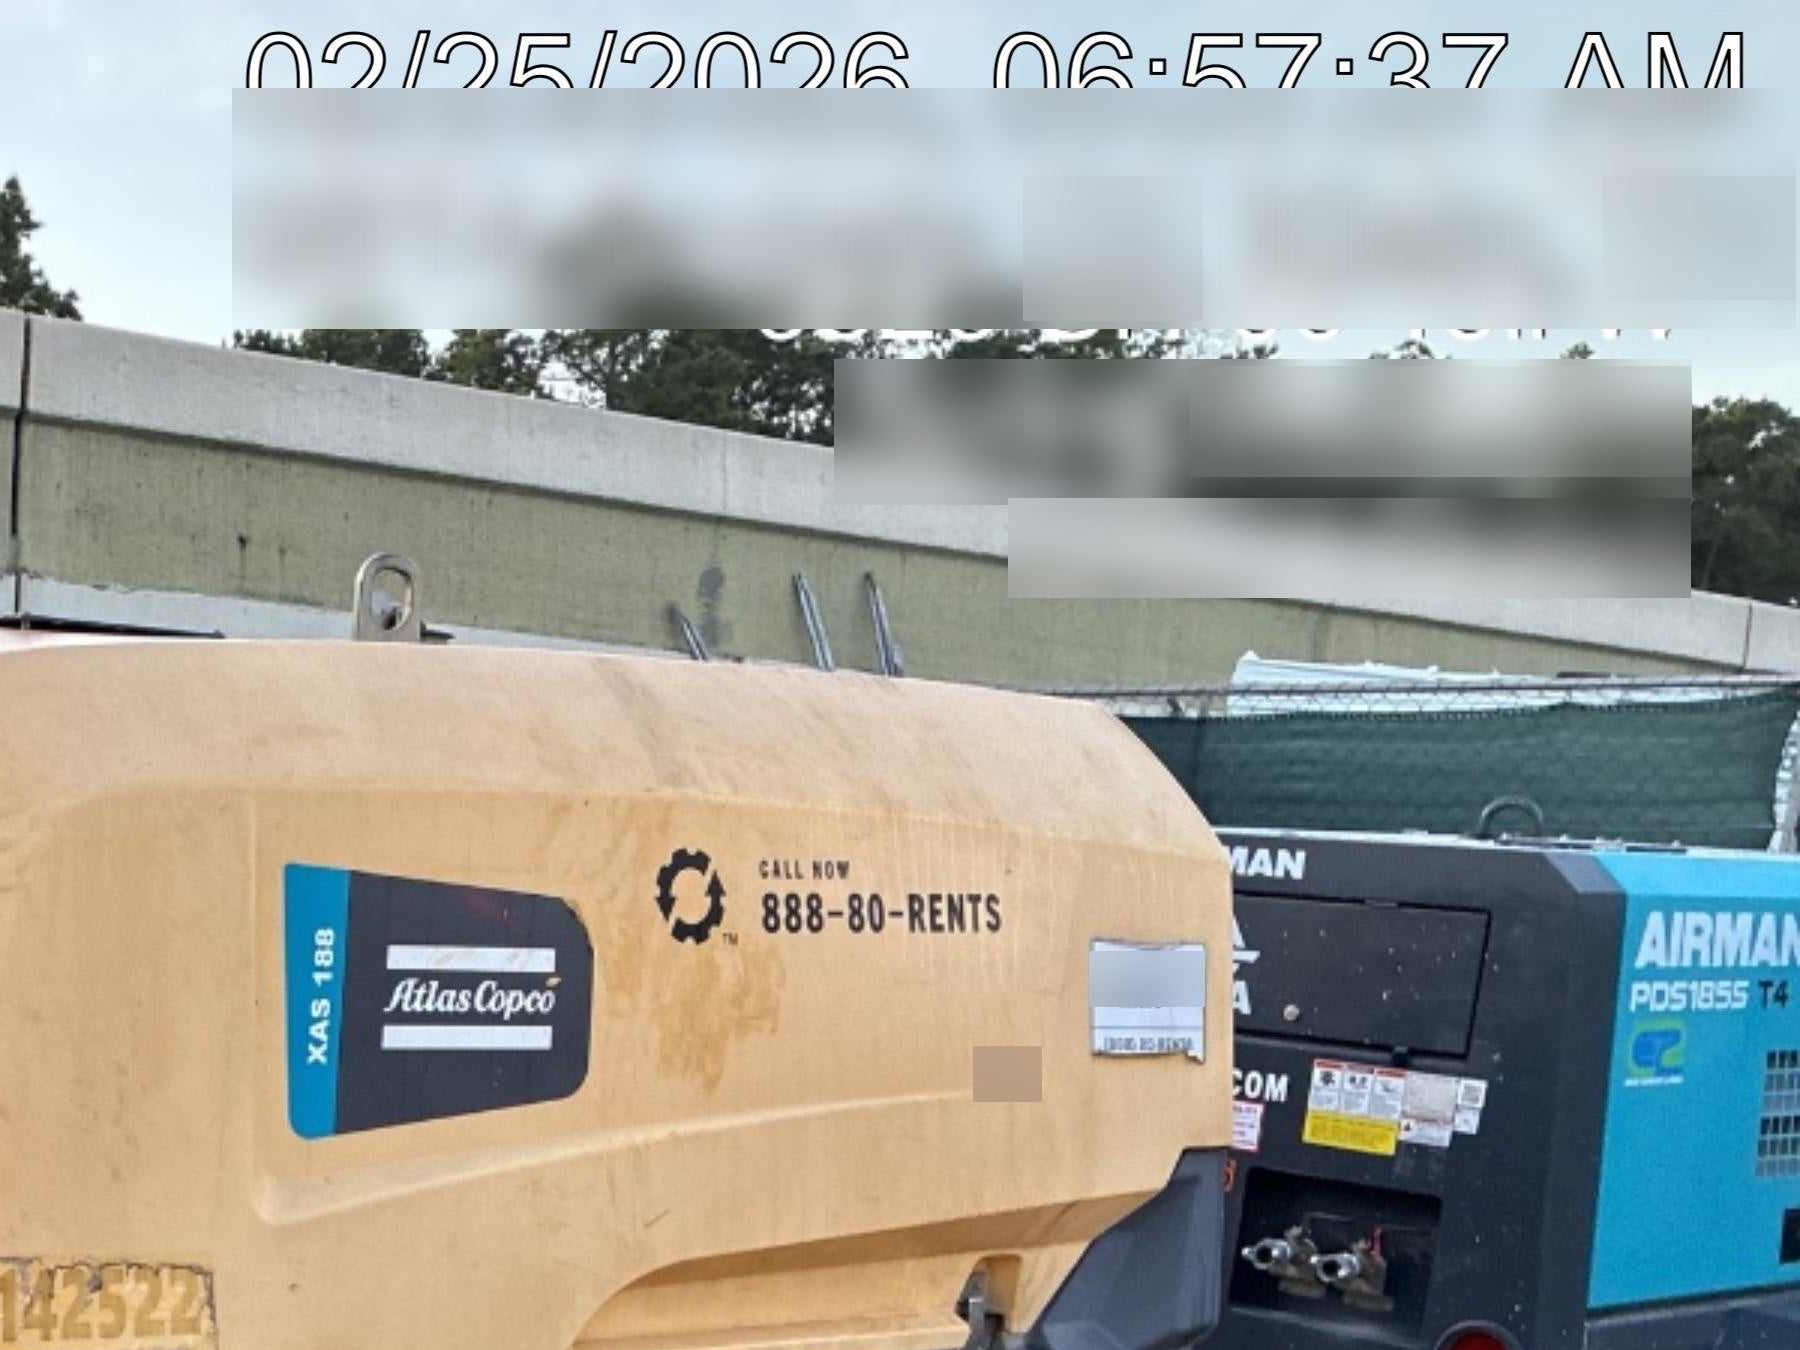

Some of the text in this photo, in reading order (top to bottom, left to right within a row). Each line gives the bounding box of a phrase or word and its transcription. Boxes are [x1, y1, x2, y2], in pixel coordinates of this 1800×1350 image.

[759, 860, 850, 880] CALL NOW
[1226, 845, 1306, 880] MAN
[762, 892, 1003, 934] 888-80-RENTS
[306, 927, 336, 1065] XAS 188
[383, 976, 556, 1021] Atlas Copco
[1758, 979, 1790, 1008] T4
